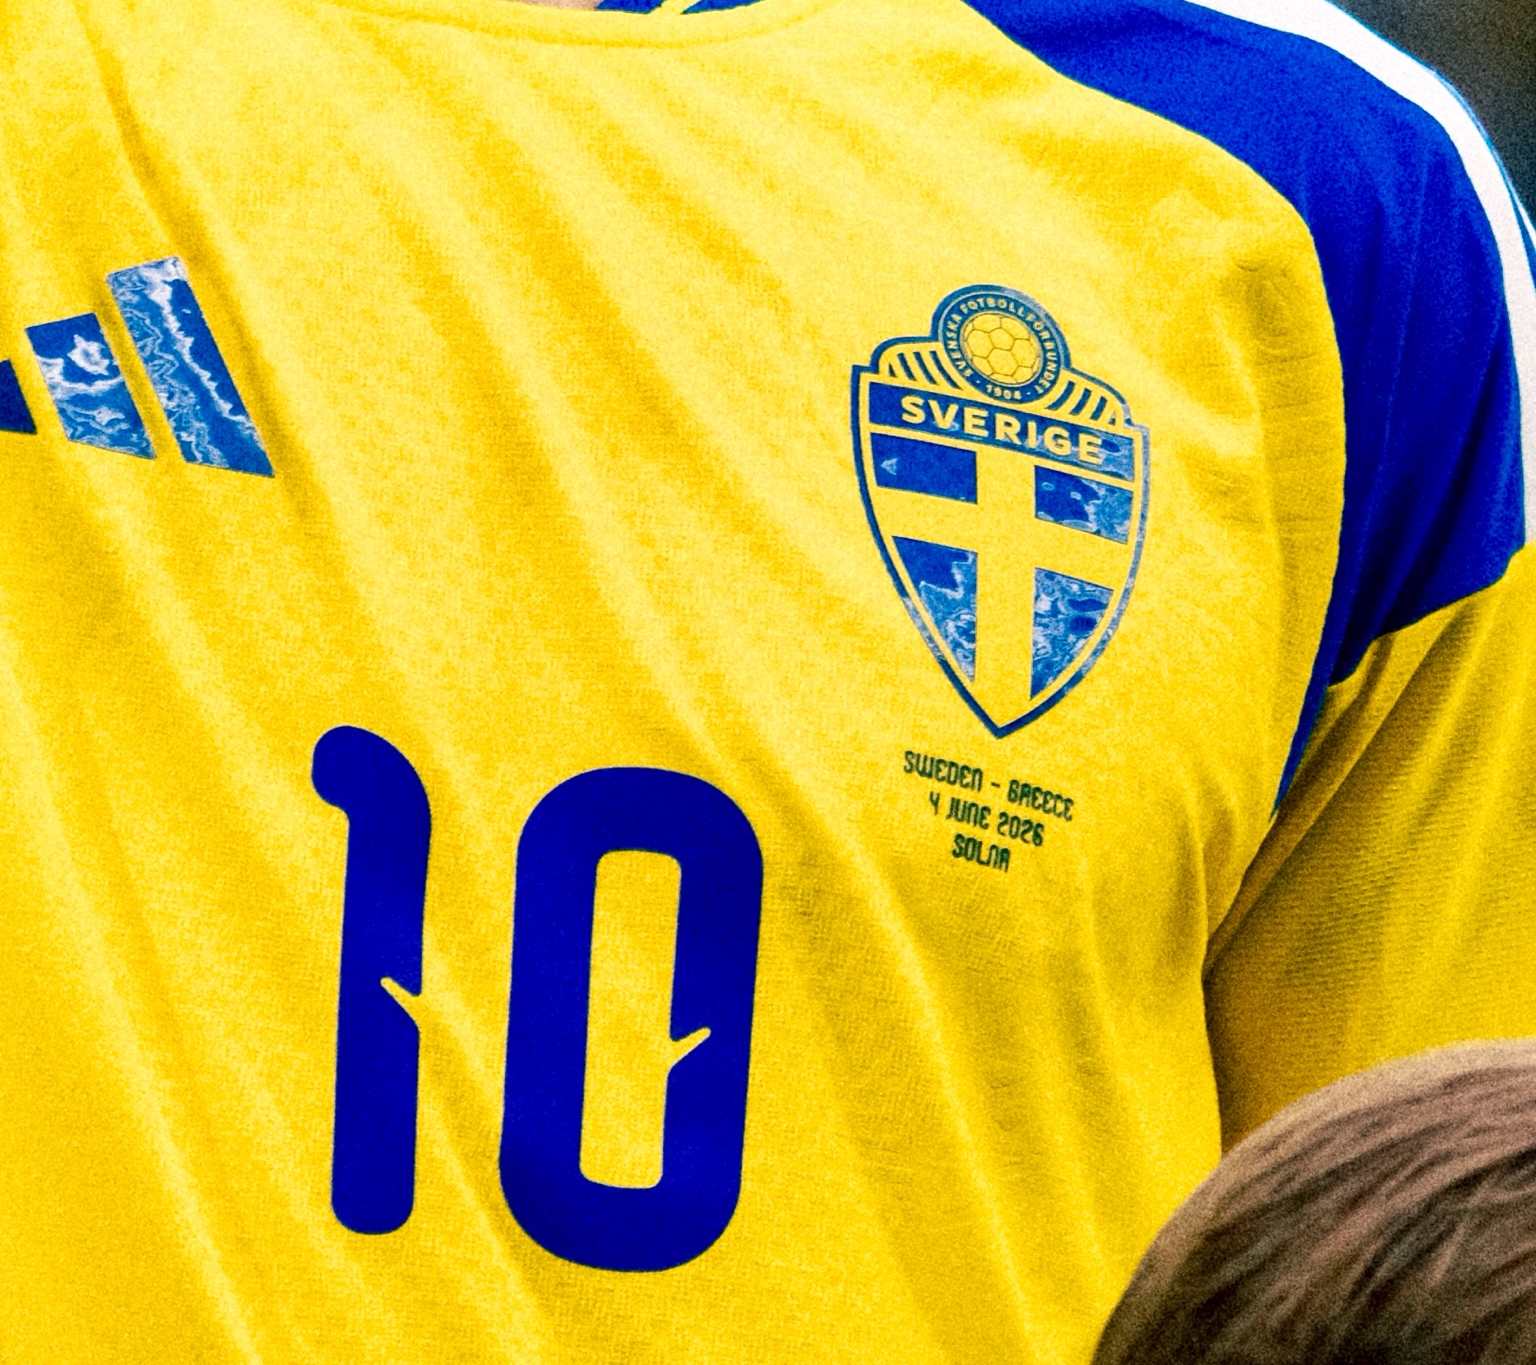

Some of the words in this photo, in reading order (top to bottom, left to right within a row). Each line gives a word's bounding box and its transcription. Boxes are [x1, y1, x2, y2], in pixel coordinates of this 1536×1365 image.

[945, 313, 973, 377] SVENSKA
[901, 395, 1103, 465] SVERIGE
[903, 750, 983, 792] SWEDEN
[1007, 779, 1074, 822] GREECE
[929, 790, 940, 816] 4
[946, 797, 991, 830] JUNE
[997, 811, 1044, 847] 2026
[952, 833, 1010, 873] SOLNA
[311, 725, 764, 1272] 10
